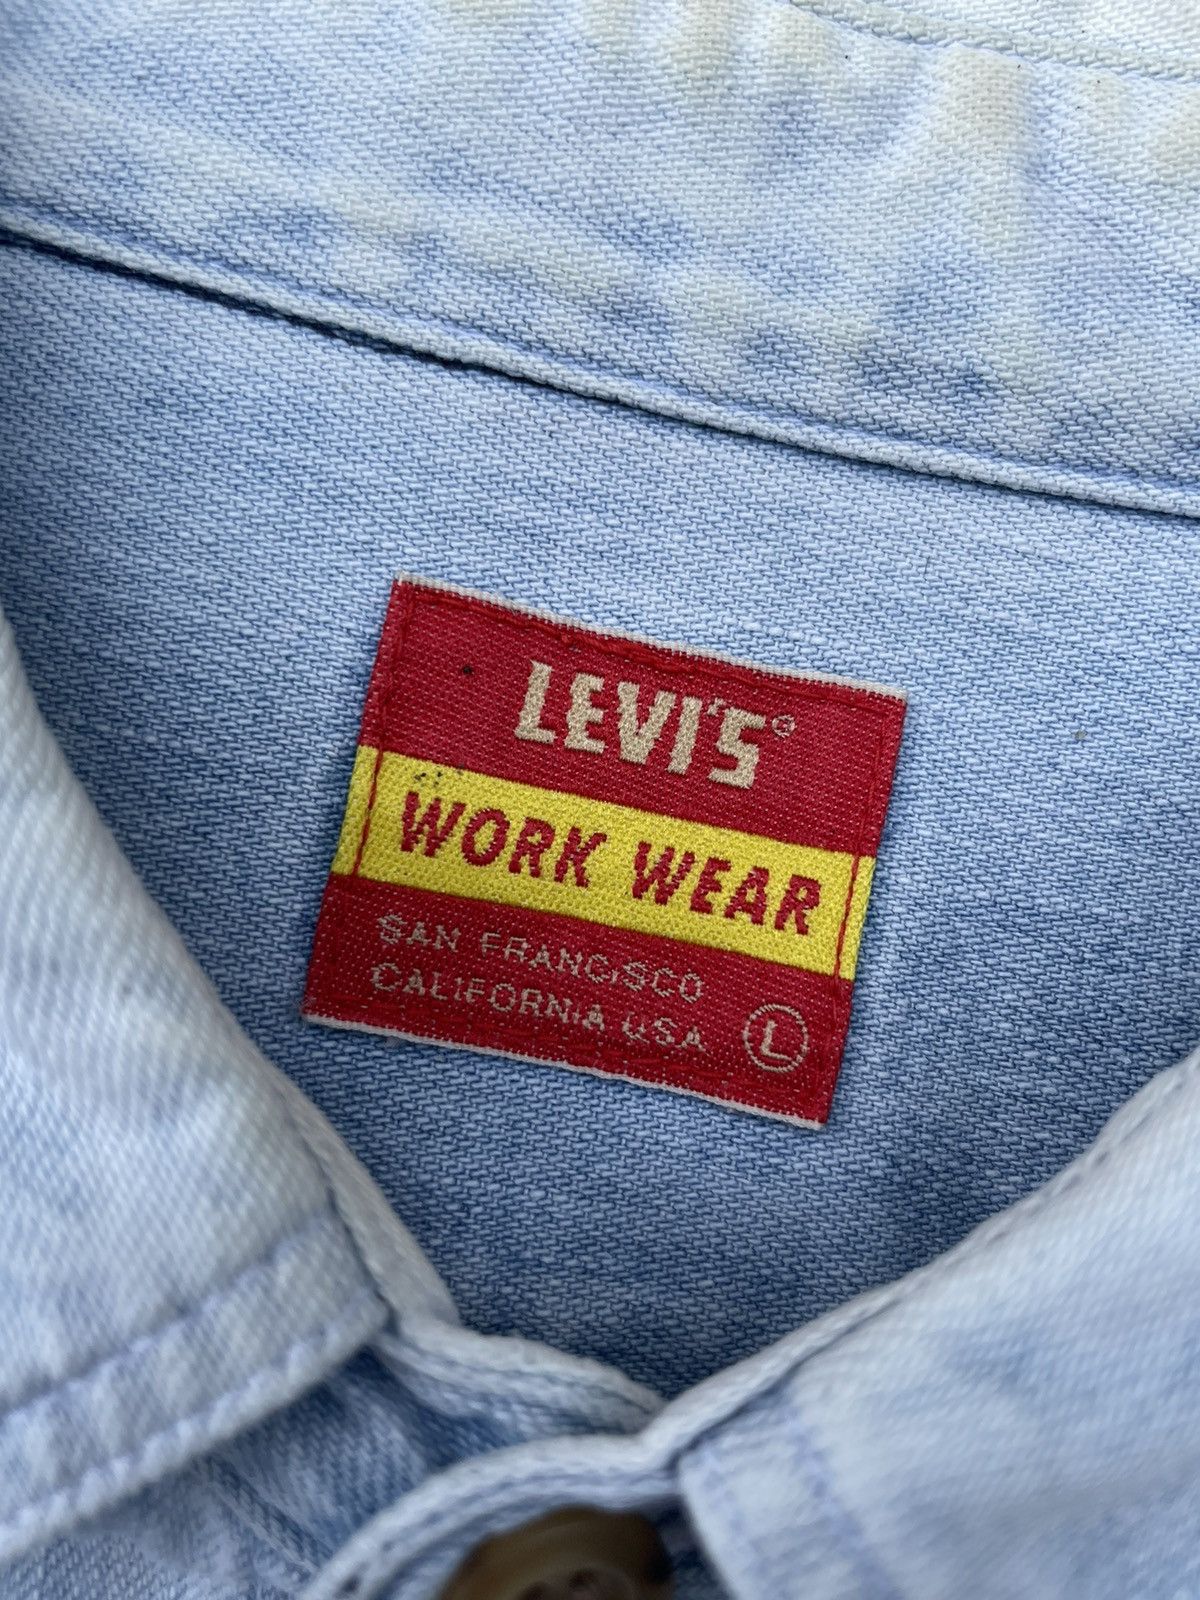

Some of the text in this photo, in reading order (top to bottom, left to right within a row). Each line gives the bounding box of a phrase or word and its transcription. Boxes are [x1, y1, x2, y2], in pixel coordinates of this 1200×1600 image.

[401, 791, 821, 935] WORK WEAR
[376, 914, 704, 1003] SAN FRANCISCO
[370, 962, 707, 1053] CALIFORNIA USA
